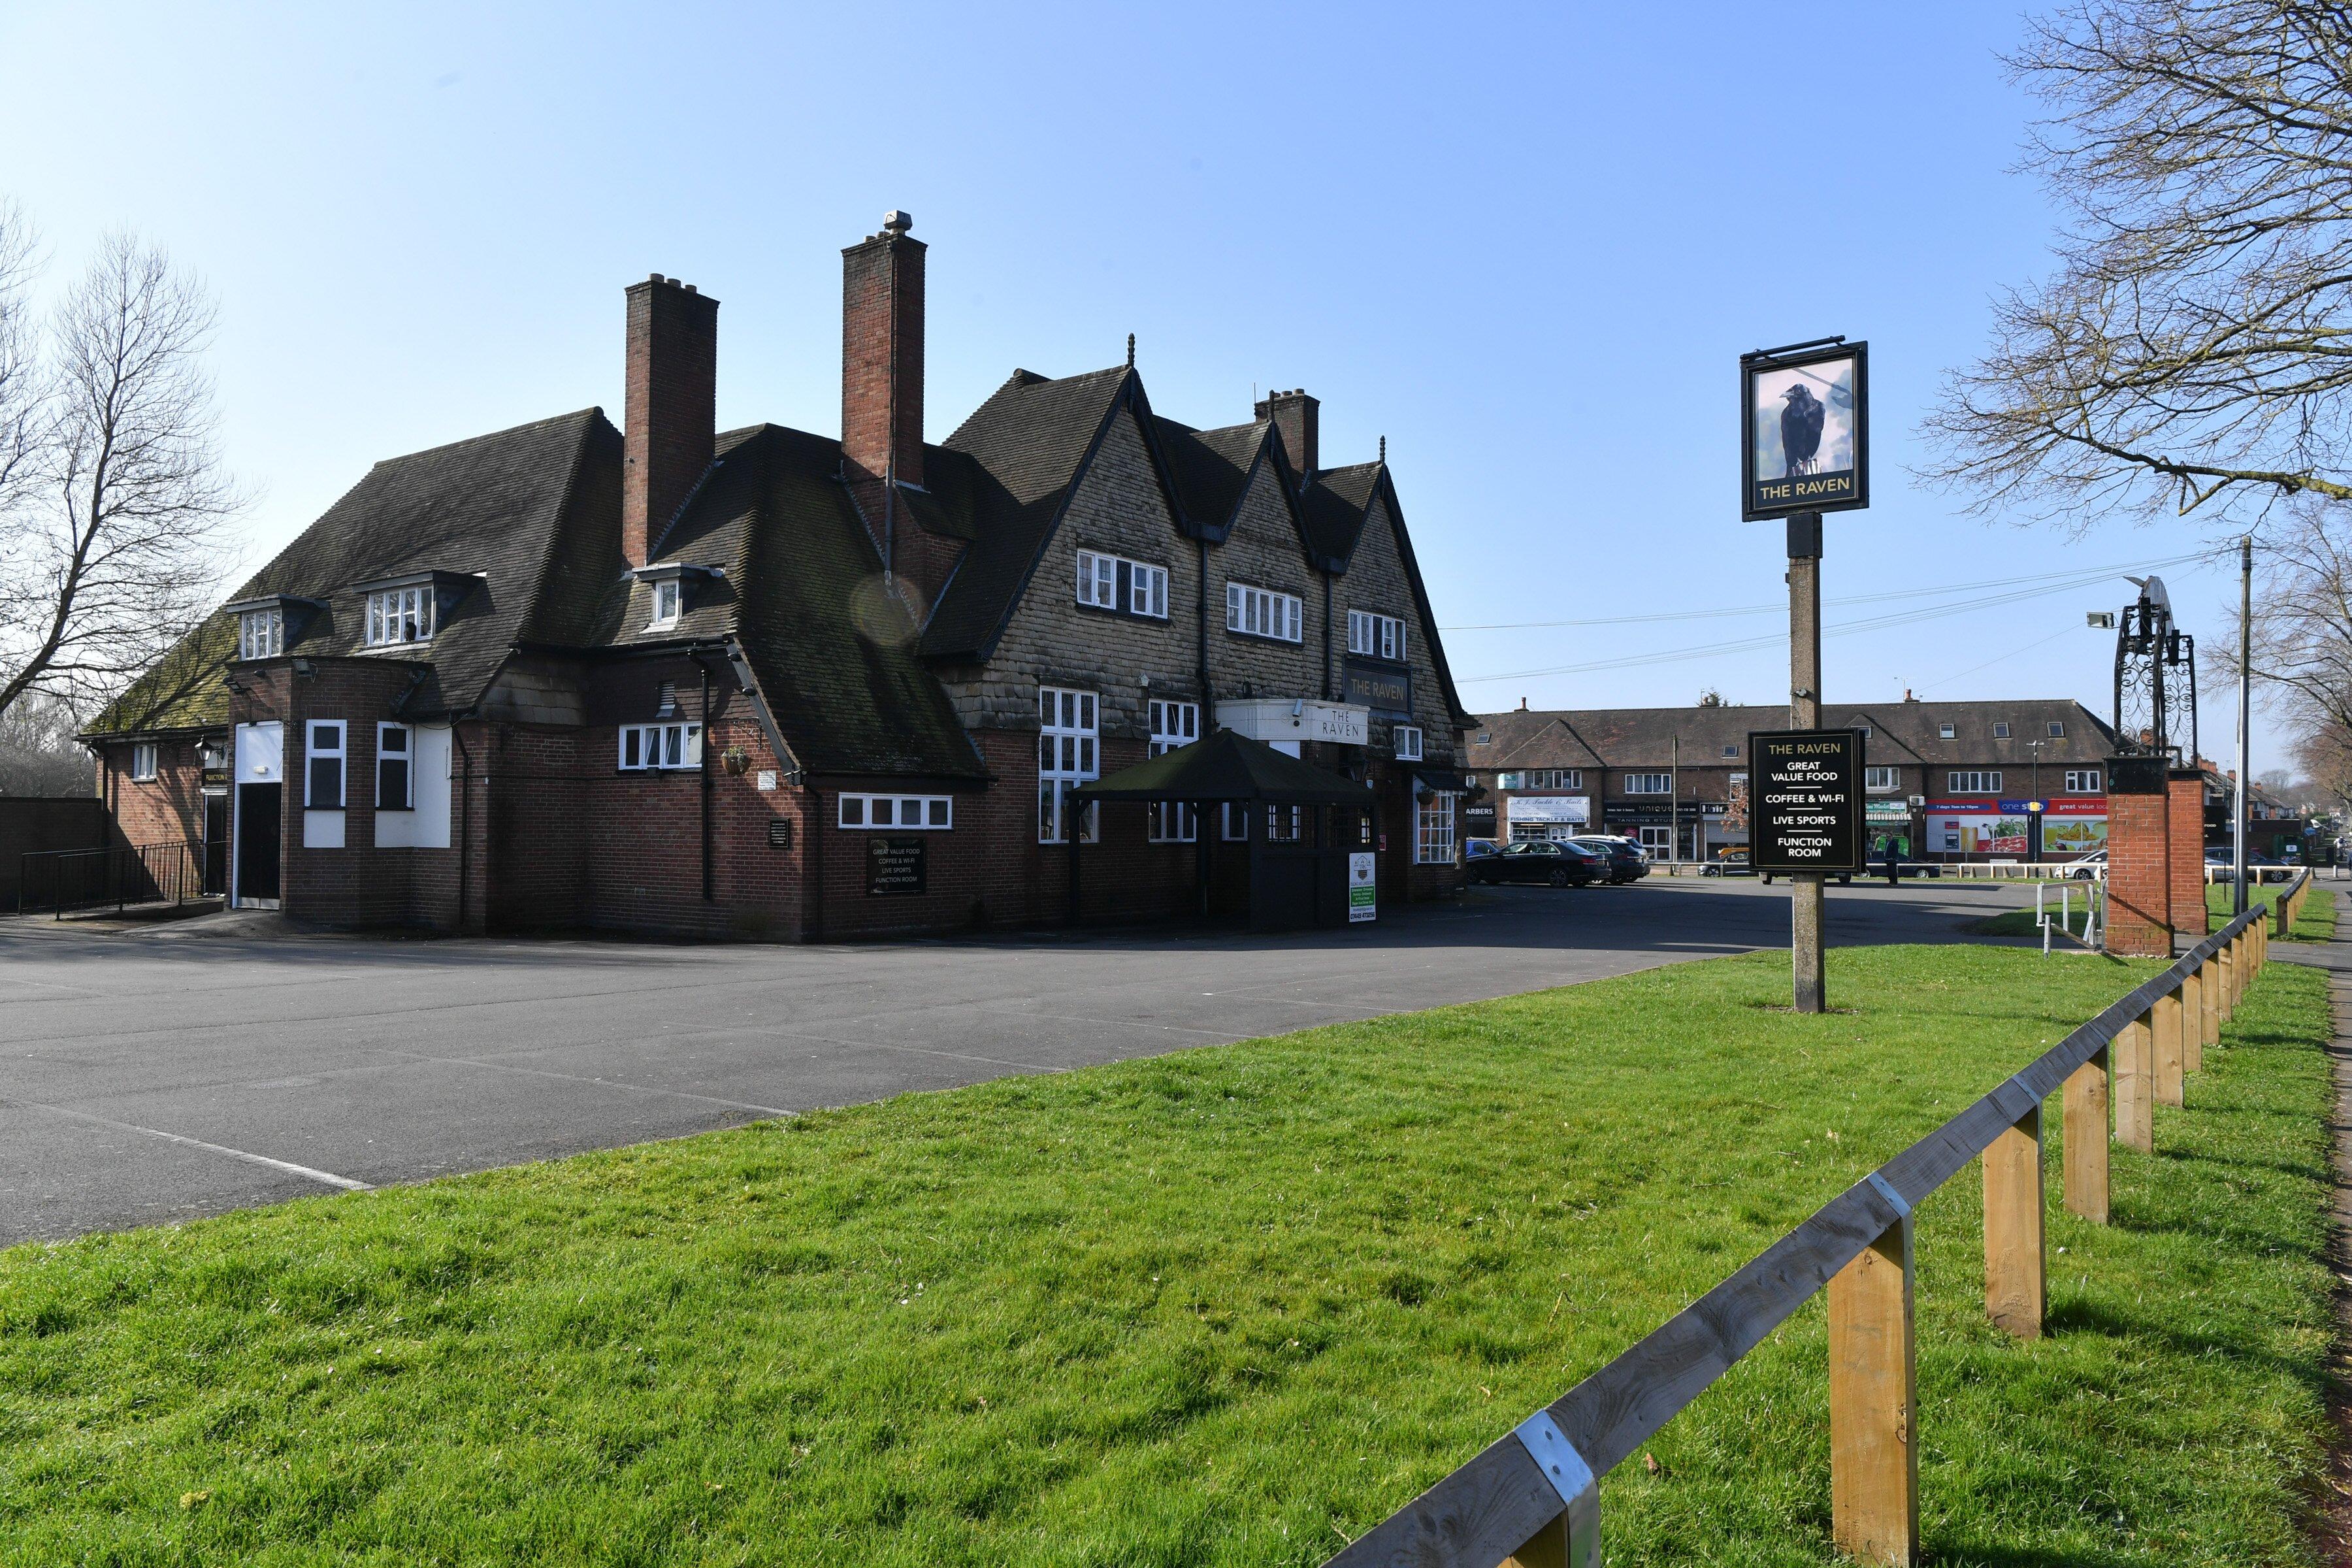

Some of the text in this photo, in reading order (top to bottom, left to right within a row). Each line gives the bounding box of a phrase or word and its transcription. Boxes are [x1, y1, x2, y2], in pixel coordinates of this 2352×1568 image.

[1760, 477, 1850, 500] THE RAVEN
[1351, 678, 1403, 700] THE RAVEN
[1332, 710, 1349, 723] THE
[1323, 722, 1358, 736] RAVEN
[1769, 743, 1840, 755] THE RAVEN
[1787, 762, 1821, 770] GREAT
[1771, 772, 1838, 781] VALUE FOOD
[1765, 794, 1844, 803] COFFEE & WI-FI
[1797, 816, 1837, 825] SPORTS
[1778, 838, 1832, 847] FUNCTION
[1788, 849, 1821, 857] ROOM
